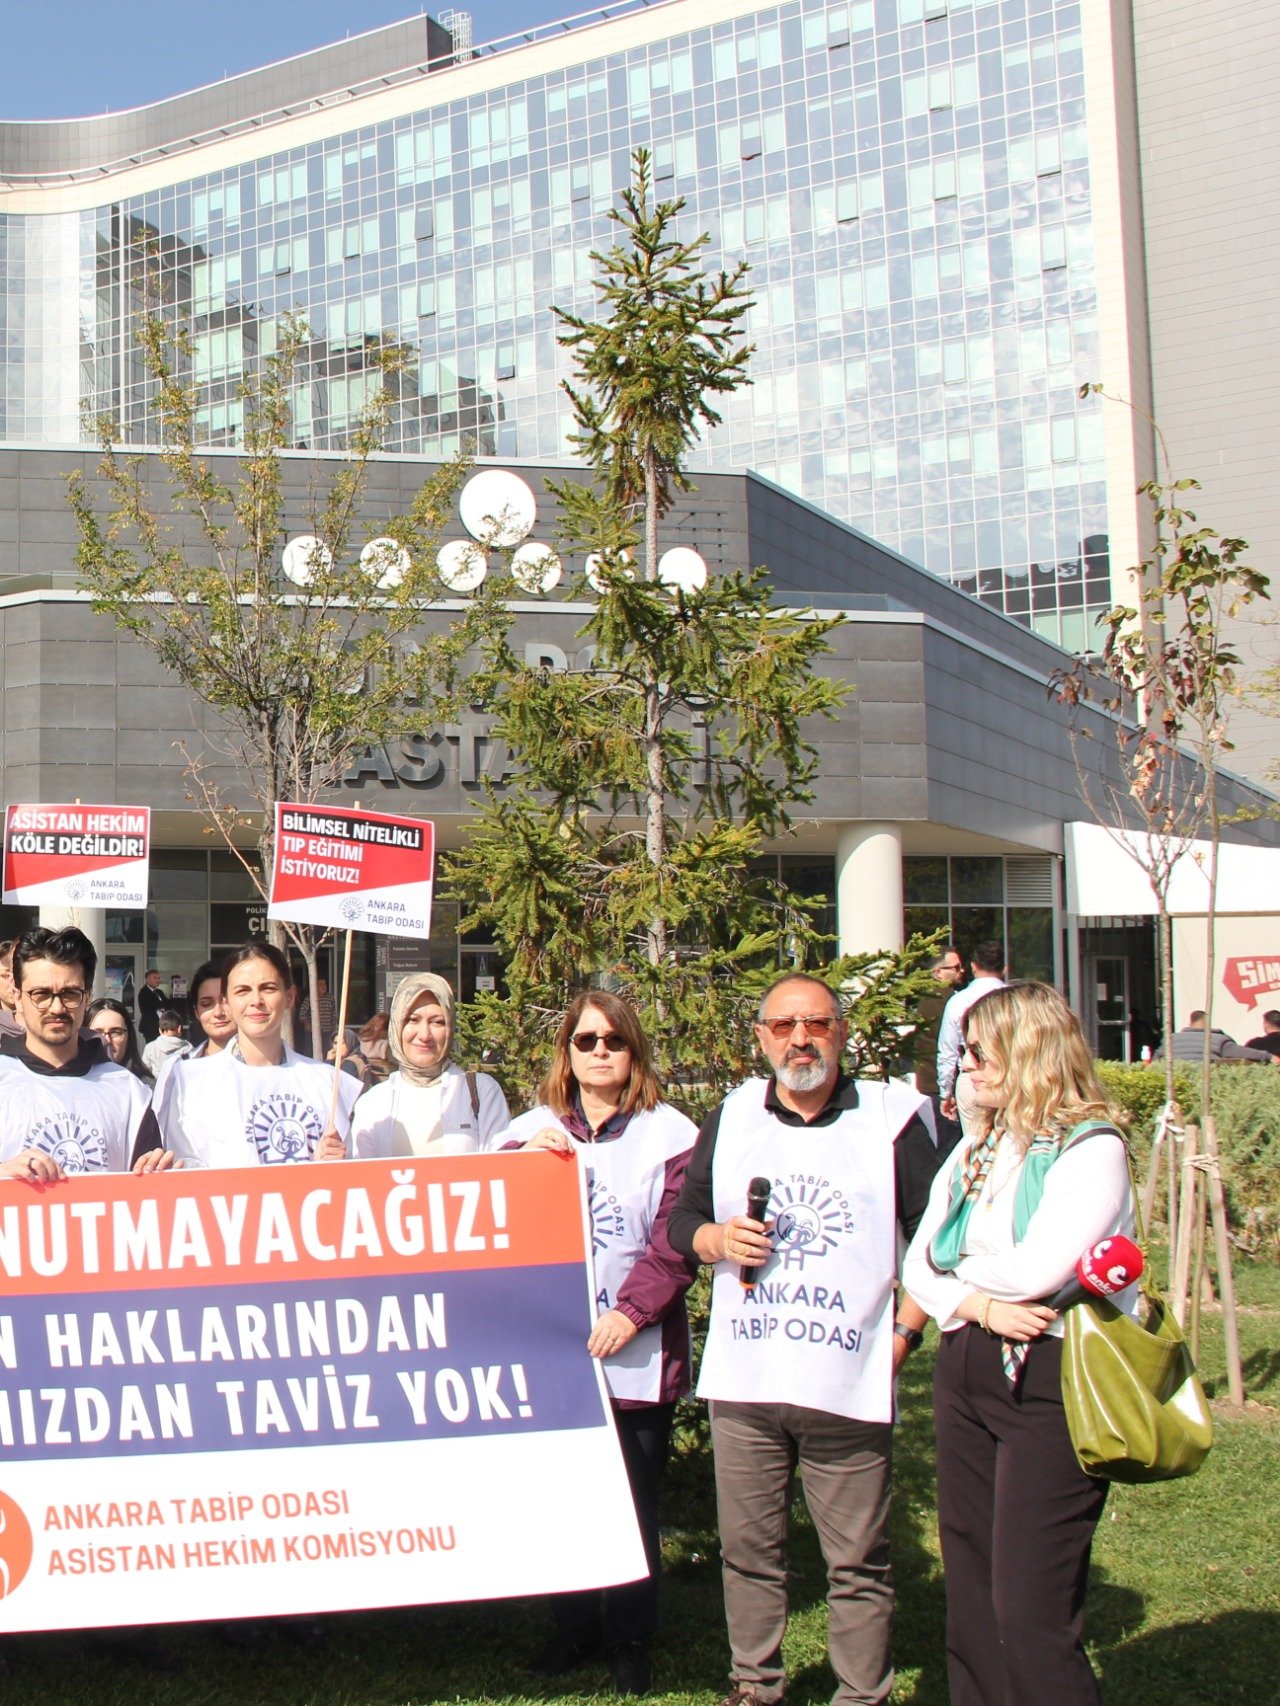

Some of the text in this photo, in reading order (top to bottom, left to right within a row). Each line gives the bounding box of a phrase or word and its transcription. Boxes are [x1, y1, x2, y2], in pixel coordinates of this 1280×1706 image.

[10, 809, 145, 833] ASİSTAN HEKİM
[283, 812, 420, 848] BİLİMSEL NİTELİKLİ
[11, 832, 144, 857] KÖLE DEĞİLDİR!
[282, 836, 363, 863] TIP EĞİTİMİ
[91, 880, 125, 889] ANKARA
[280, 855, 360, 885] İSTİYORUZ!
[116, 893, 143, 902] ODASI
[367, 899, 406, 912] ANKARA
[395, 917, 425, 929] ODASI
[245, 1099, 267, 1143] ANKARA
[91, 1128, 109, 1167] ODASI
[588, 1179, 625, 1237] BİP ODASI
[790, 1174, 855, 1234] TABİP ODASI
[743, 1282, 846, 1313] ANKARA
[44, 1292, 448, 1369] HAKLARINDAN
[731, 1313, 862, 1353] TABİP ODASI
[217, 1364, 380, 1437] TAVİZ
[396, 1363, 534, 1427] YOK!
[44, 1489, 350, 1531] ANKARA TABİP ODASI
[47, 1525, 457, 1577] ASİSTAN HEKİM KOMİSYONU
